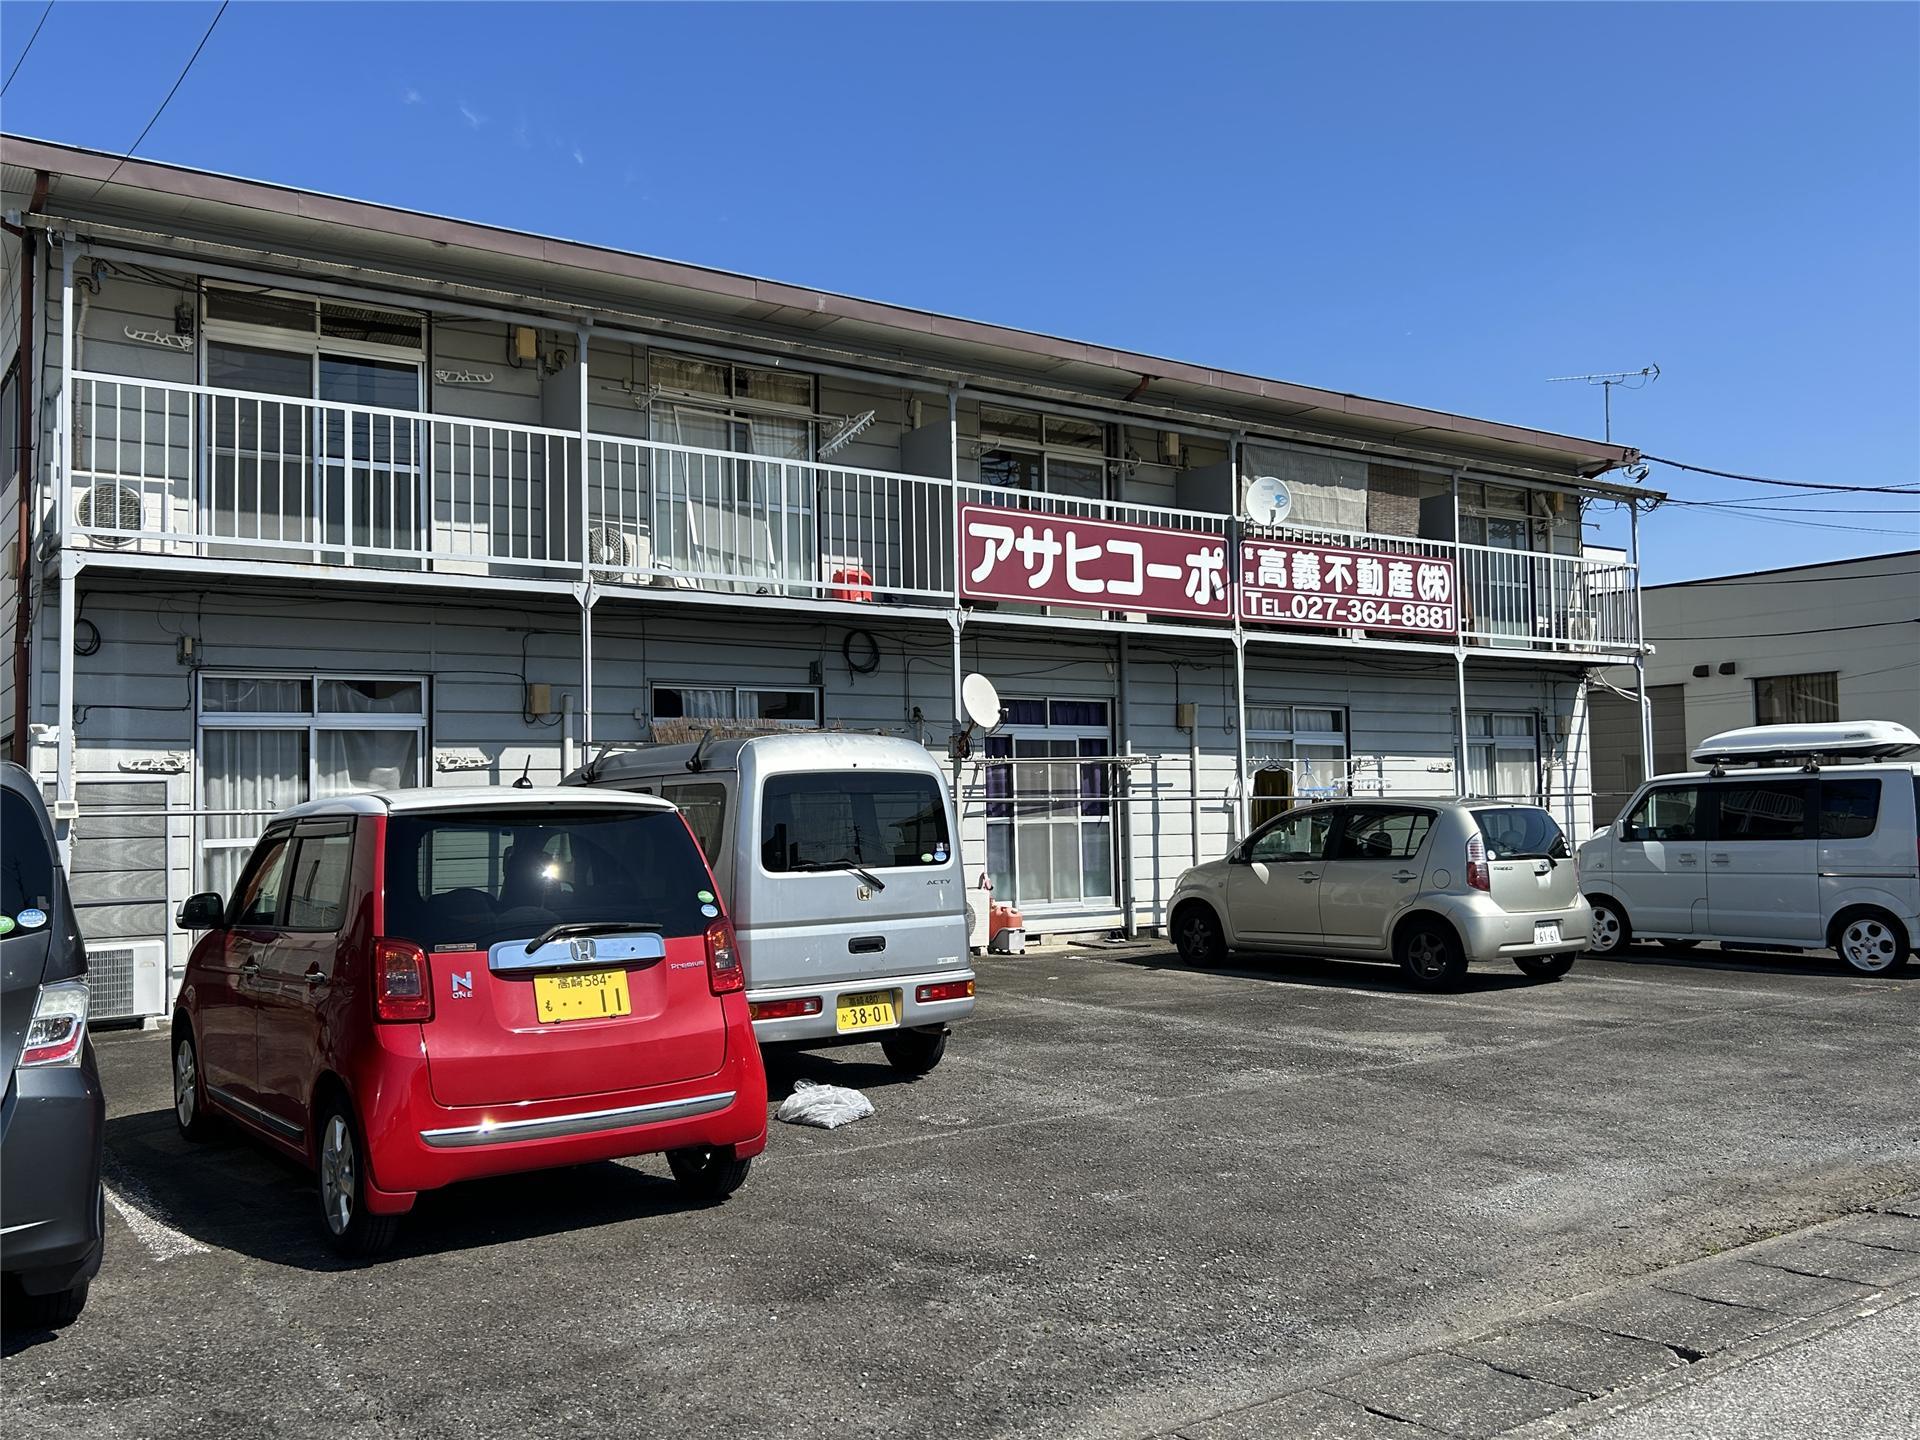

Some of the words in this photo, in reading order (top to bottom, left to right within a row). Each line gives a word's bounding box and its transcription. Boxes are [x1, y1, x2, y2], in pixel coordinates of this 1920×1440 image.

[968, 522, 1227, 605] アサヒコーポ
[926, 878, 952, 886] ACTY
[670, 960, 705, 970] Premium
[451, 970, 473, 991] N
[452, 991, 473, 999] ONE
[849, 1004, 889, 1025] 38-01
